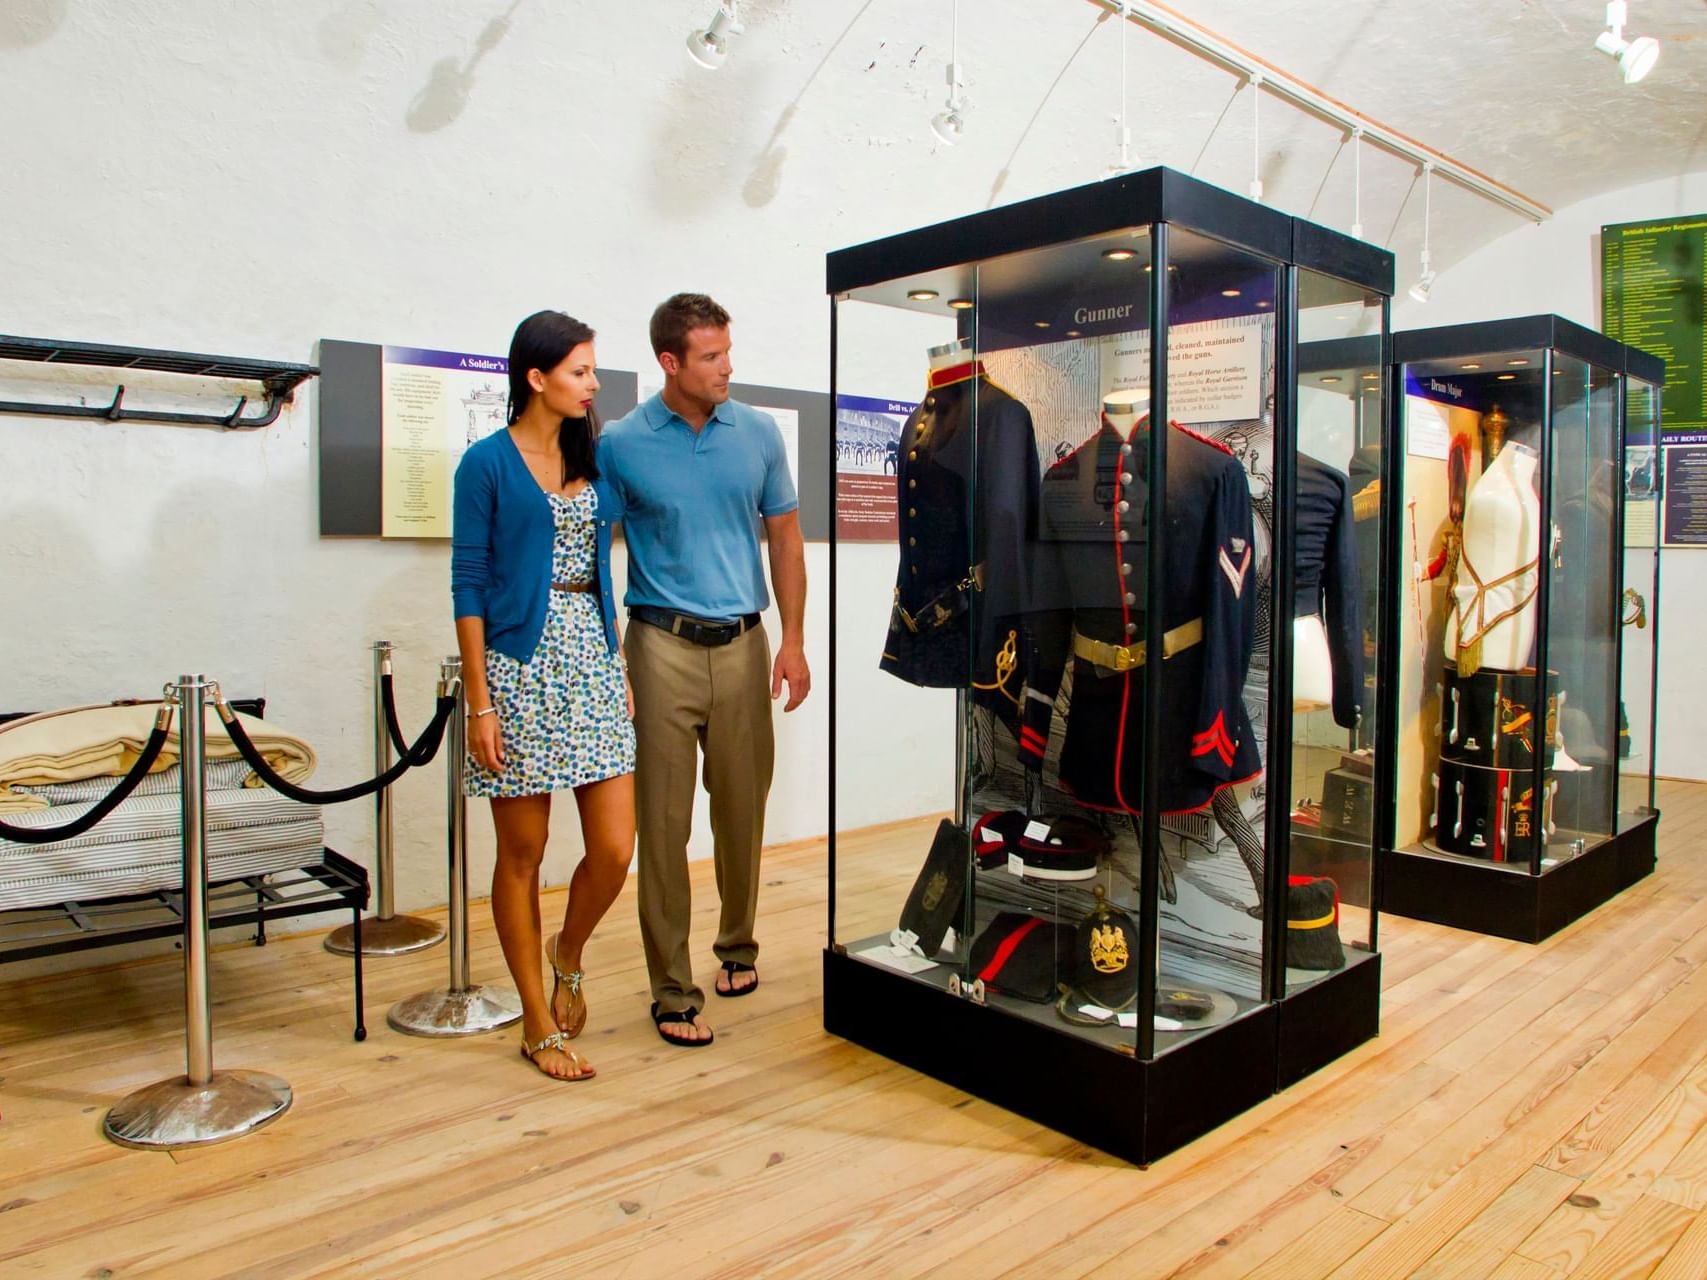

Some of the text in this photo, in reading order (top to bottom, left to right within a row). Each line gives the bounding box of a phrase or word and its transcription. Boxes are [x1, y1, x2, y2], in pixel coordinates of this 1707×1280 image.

[1074, 304, 1133, 324] Gunner
[1114, 348, 1142, 357] Gunners
[1175, 341, 1203, 350] cleaned,
[1205, 336, 1245, 346] maintained
[1194, 352, 1212, 360] guns.
[459, 357, 467, 367] A
[468, 358, 505, 371] Soldier's
[1188, 369, 1204, 377] Royal
[1431, 378, 1463, 399] Drum Major
[888, 402, 900, 412] Drill
